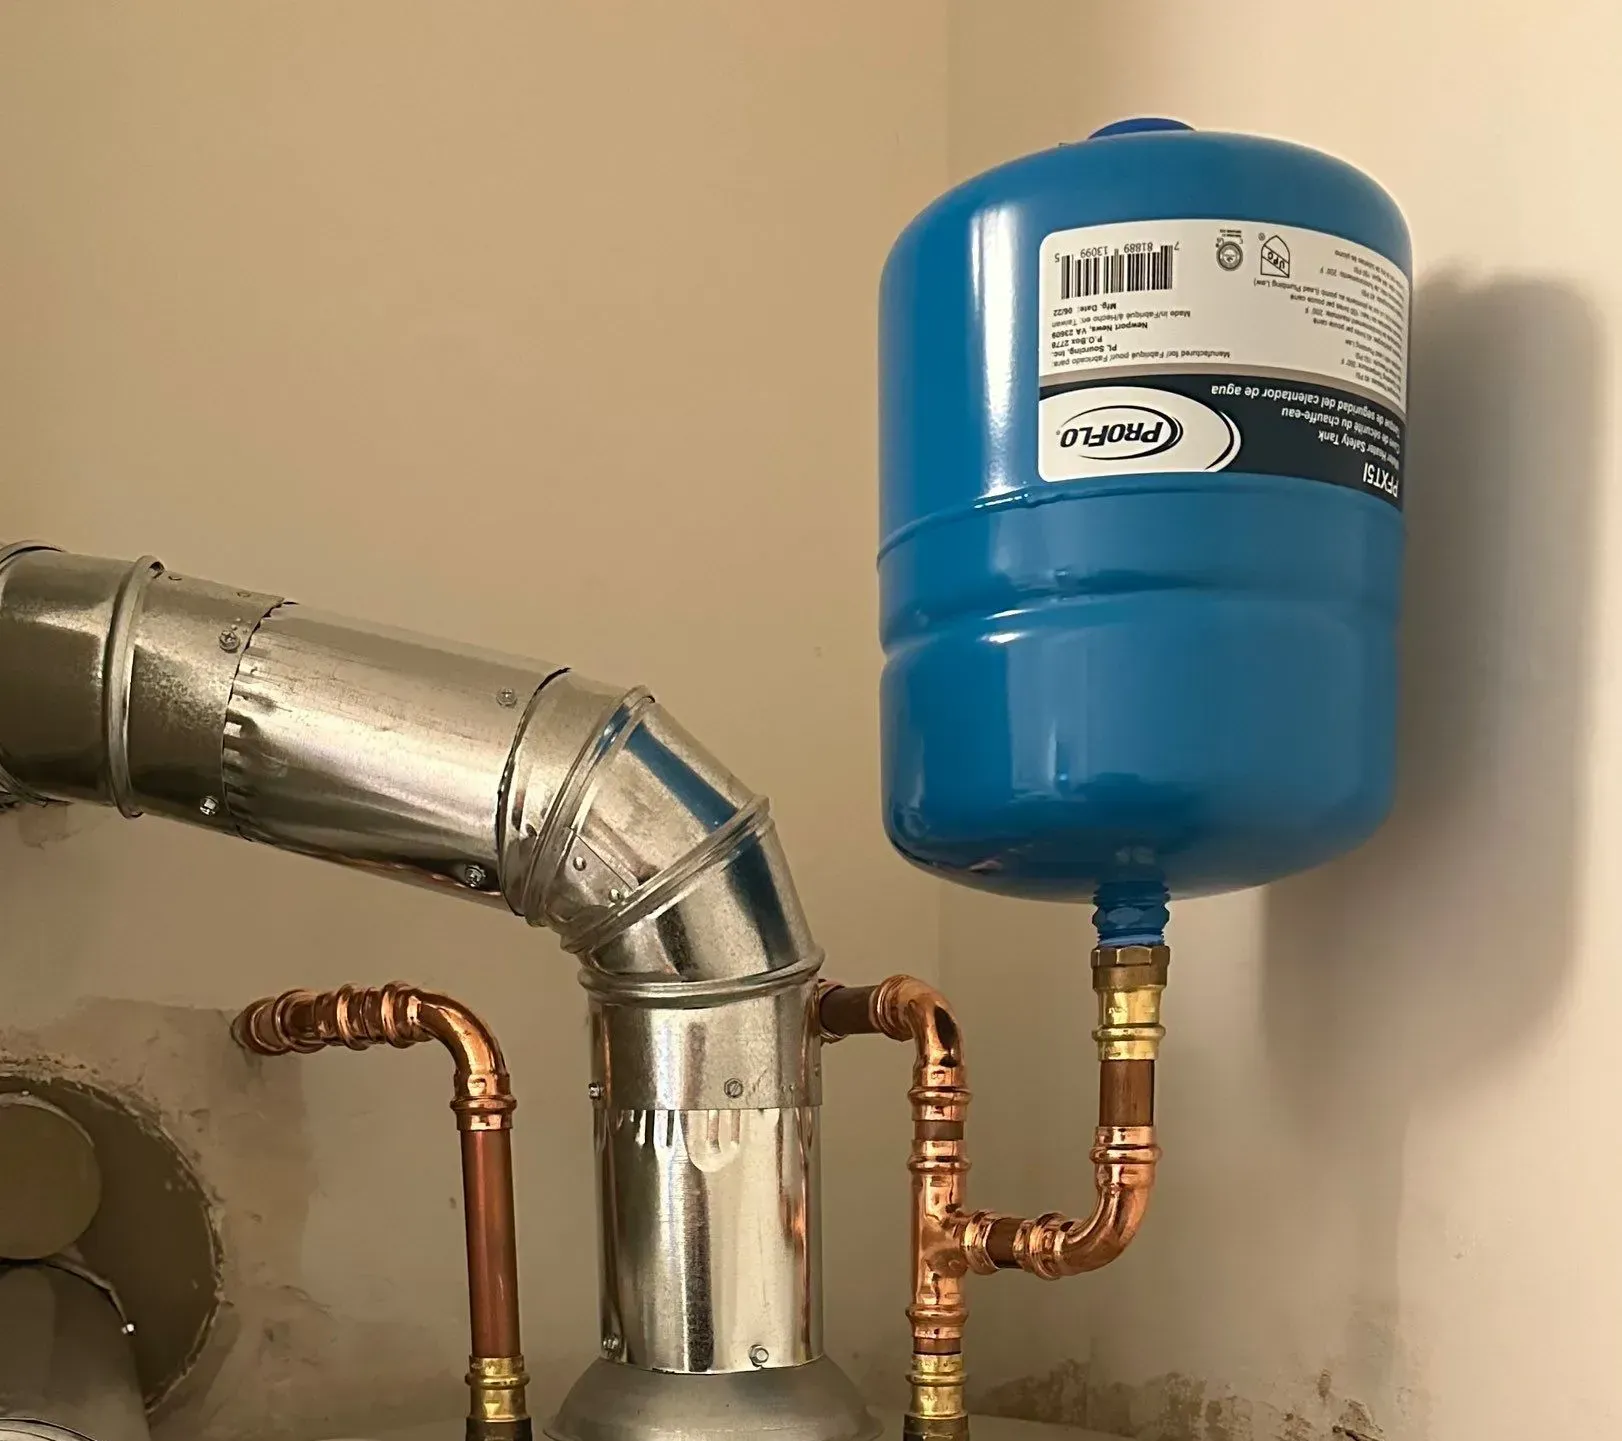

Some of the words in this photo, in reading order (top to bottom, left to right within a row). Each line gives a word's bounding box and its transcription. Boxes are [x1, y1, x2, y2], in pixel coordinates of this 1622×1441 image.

[1124, 242, 1153, 253] 81889
[1174, 241, 1180, 250] 7
[1054, 253, 1060, 262] 5
[1080, 246, 1108, 258] 13099
[1267, 252, 1285, 270] UPC
[1100, 302, 1116, 310] Mfg.
[1052, 319, 1077, 328] Taiwan
[1115, 321, 1148, 331] Newport
[1107, 344, 1117, 352] PL
[1181, 350, 1230, 358] Manufactured
[1072, 355, 1108, 365] Fabricado
[1211, 383, 1242, 395] agua
[1244, 387, 1260, 399] de
[1262, 388, 1319, 405] calentador
[1322, 396, 1335, 409] del
[1338, 401, 1375, 420] seguridad
[1282, 407, 1339, 427] chauffe-eau
[1341, 419, 1352, 430] du
[1317, 430, 1339, 445] Tank
[1341, 434, 1366, 453] Safety
